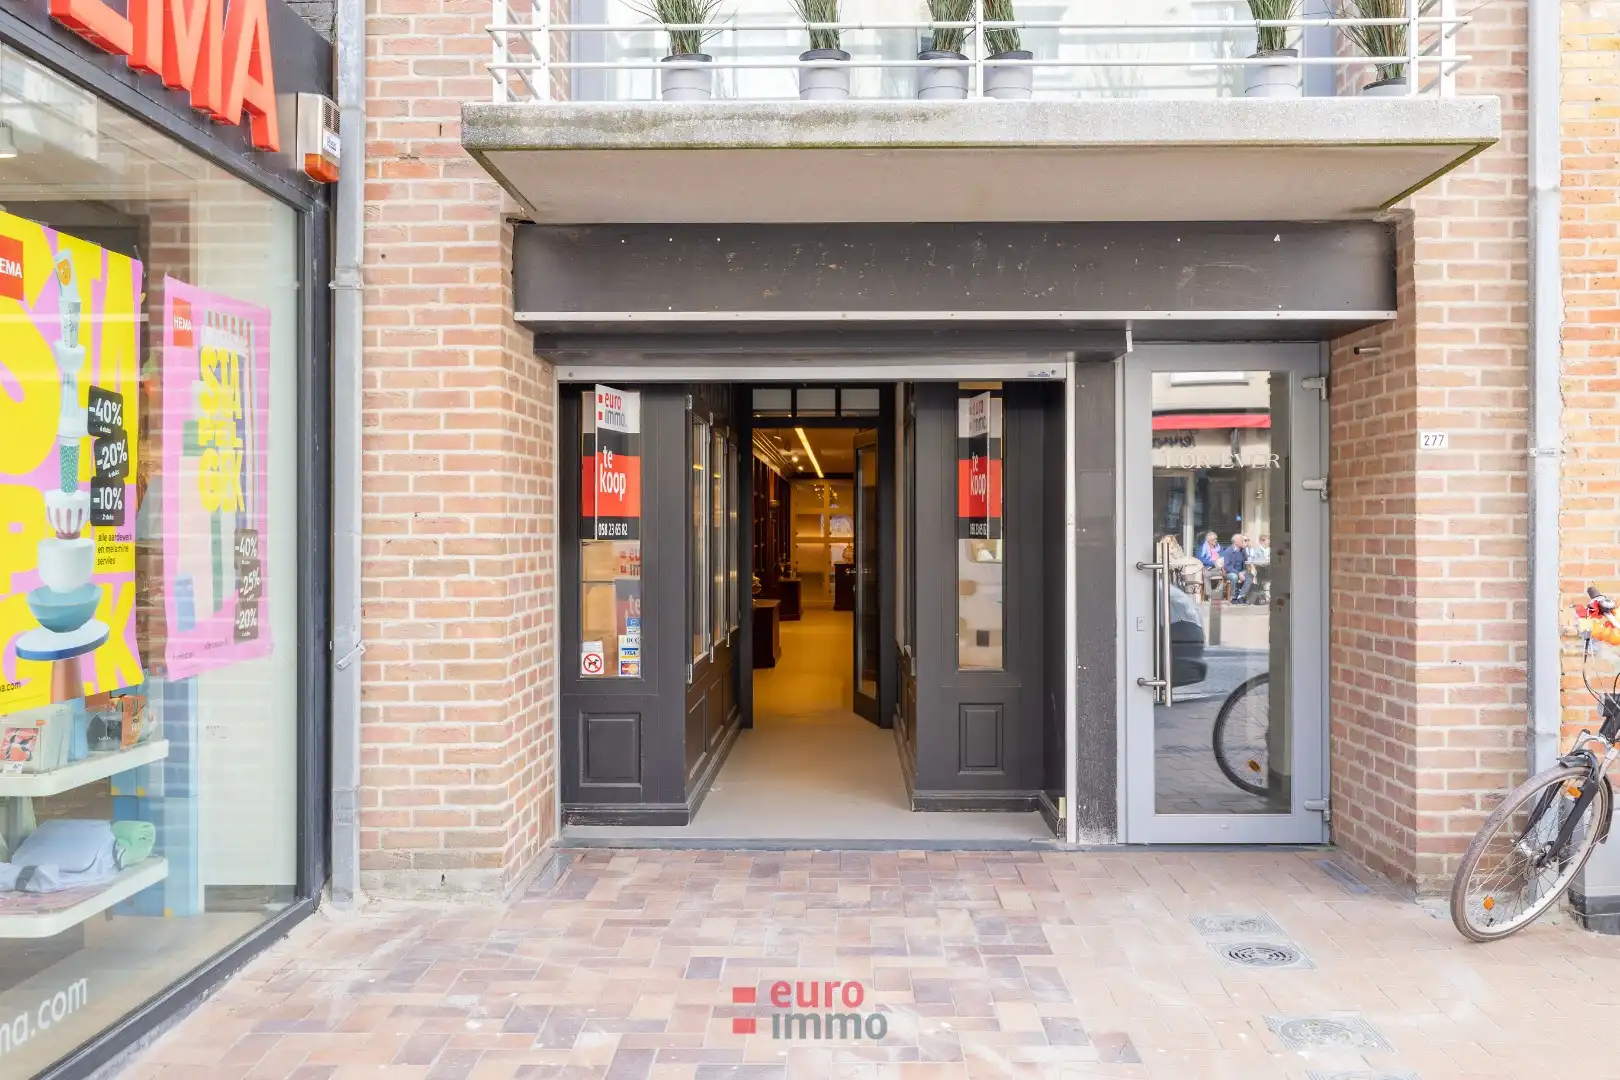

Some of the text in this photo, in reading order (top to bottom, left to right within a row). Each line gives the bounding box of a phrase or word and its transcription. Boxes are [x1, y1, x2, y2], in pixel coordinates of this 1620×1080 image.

[173, 316, 193, 332] HEMA
[200, 344, 242, 420] STA
[89, 397, 122, 427] -40%
[605, 392, 622, 410] euro
[1424, 434, 1445, 447] 277
[97, 438, 128, 471] -20%
[603, 445, 613, 469] te
[972, 452, 979, 472] te
[600, 463, 626, 502] koop
[970, 469, 986, 503] koop
[93, 486, 122, 510] -10%
[98, 531, 132, 542] alle aardewerk
[608, 523, 615, 536] 23
[97, 544, 129, 554] en melamine
[235, 536, 257, 557] -40%
[97, 556, 116, 566] servies
[239, 567, 261, 596] -25%
[235, 607, 257, 630] -20%
